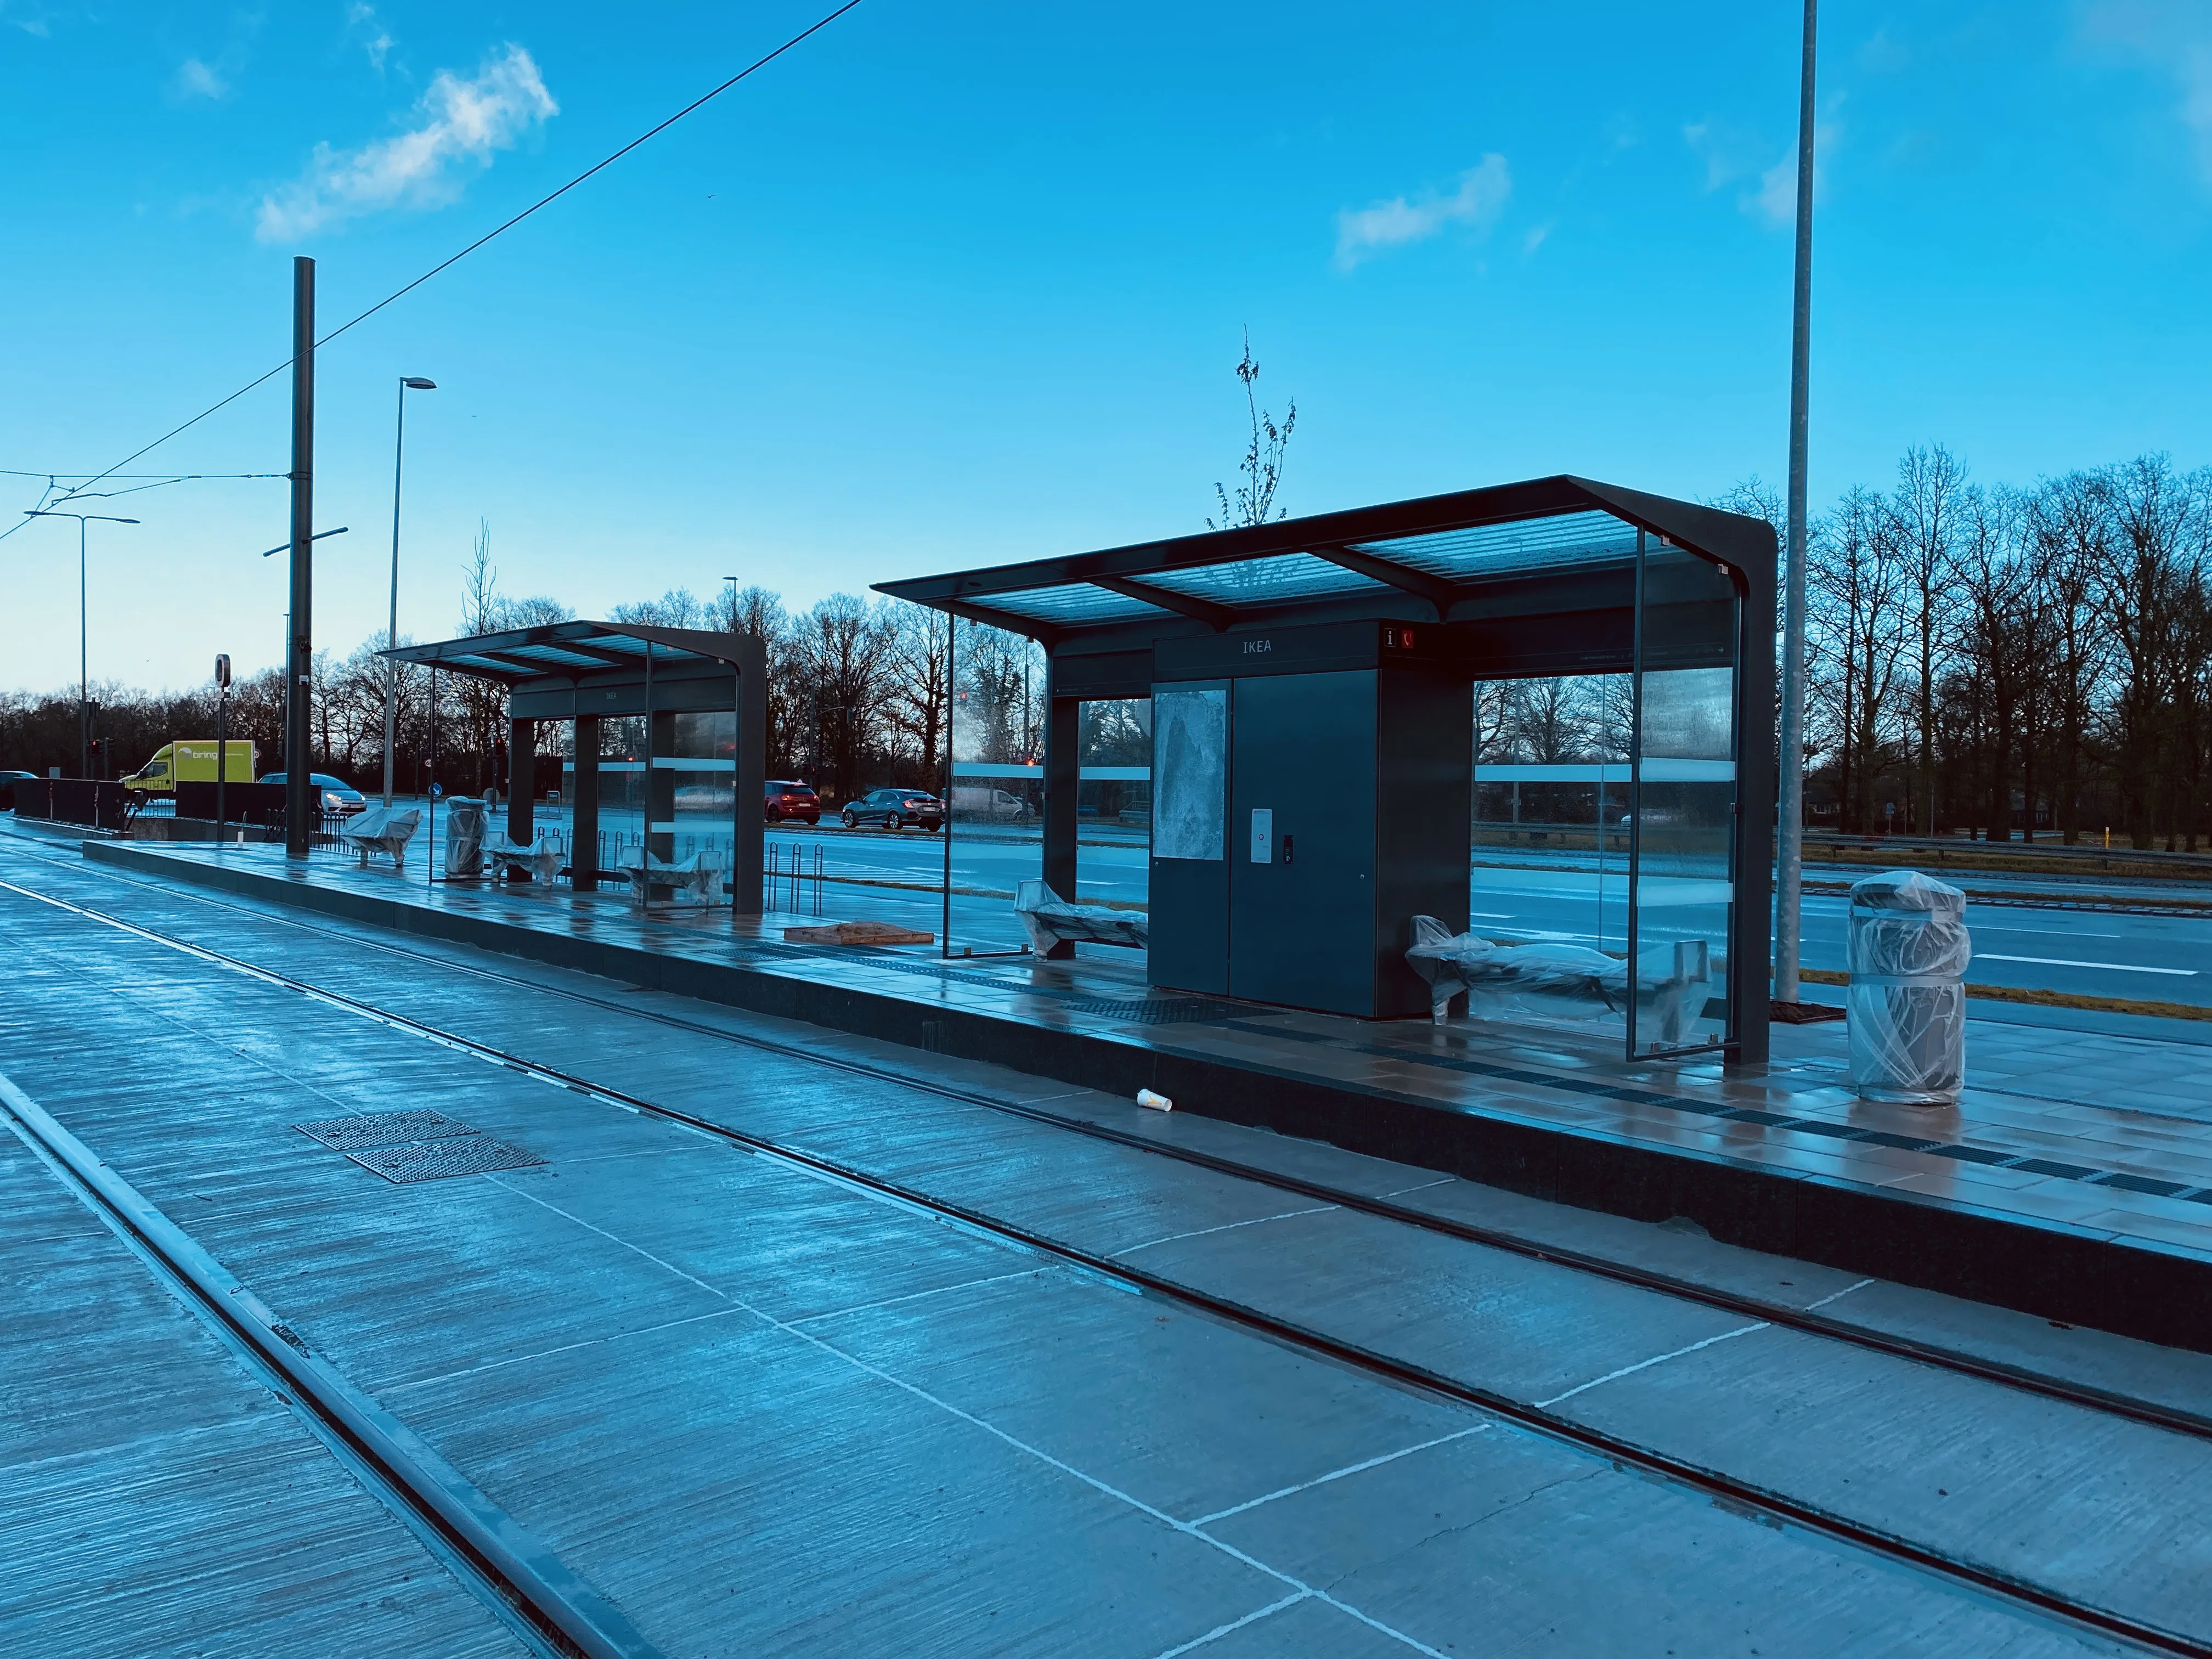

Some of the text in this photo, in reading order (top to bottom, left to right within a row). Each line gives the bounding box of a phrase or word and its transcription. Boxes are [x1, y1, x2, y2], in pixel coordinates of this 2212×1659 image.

[1243, 640, 1272, 653] IKEA
[606, 692, 617, 700] IKEA
[193, 751, 218, 760] bring
